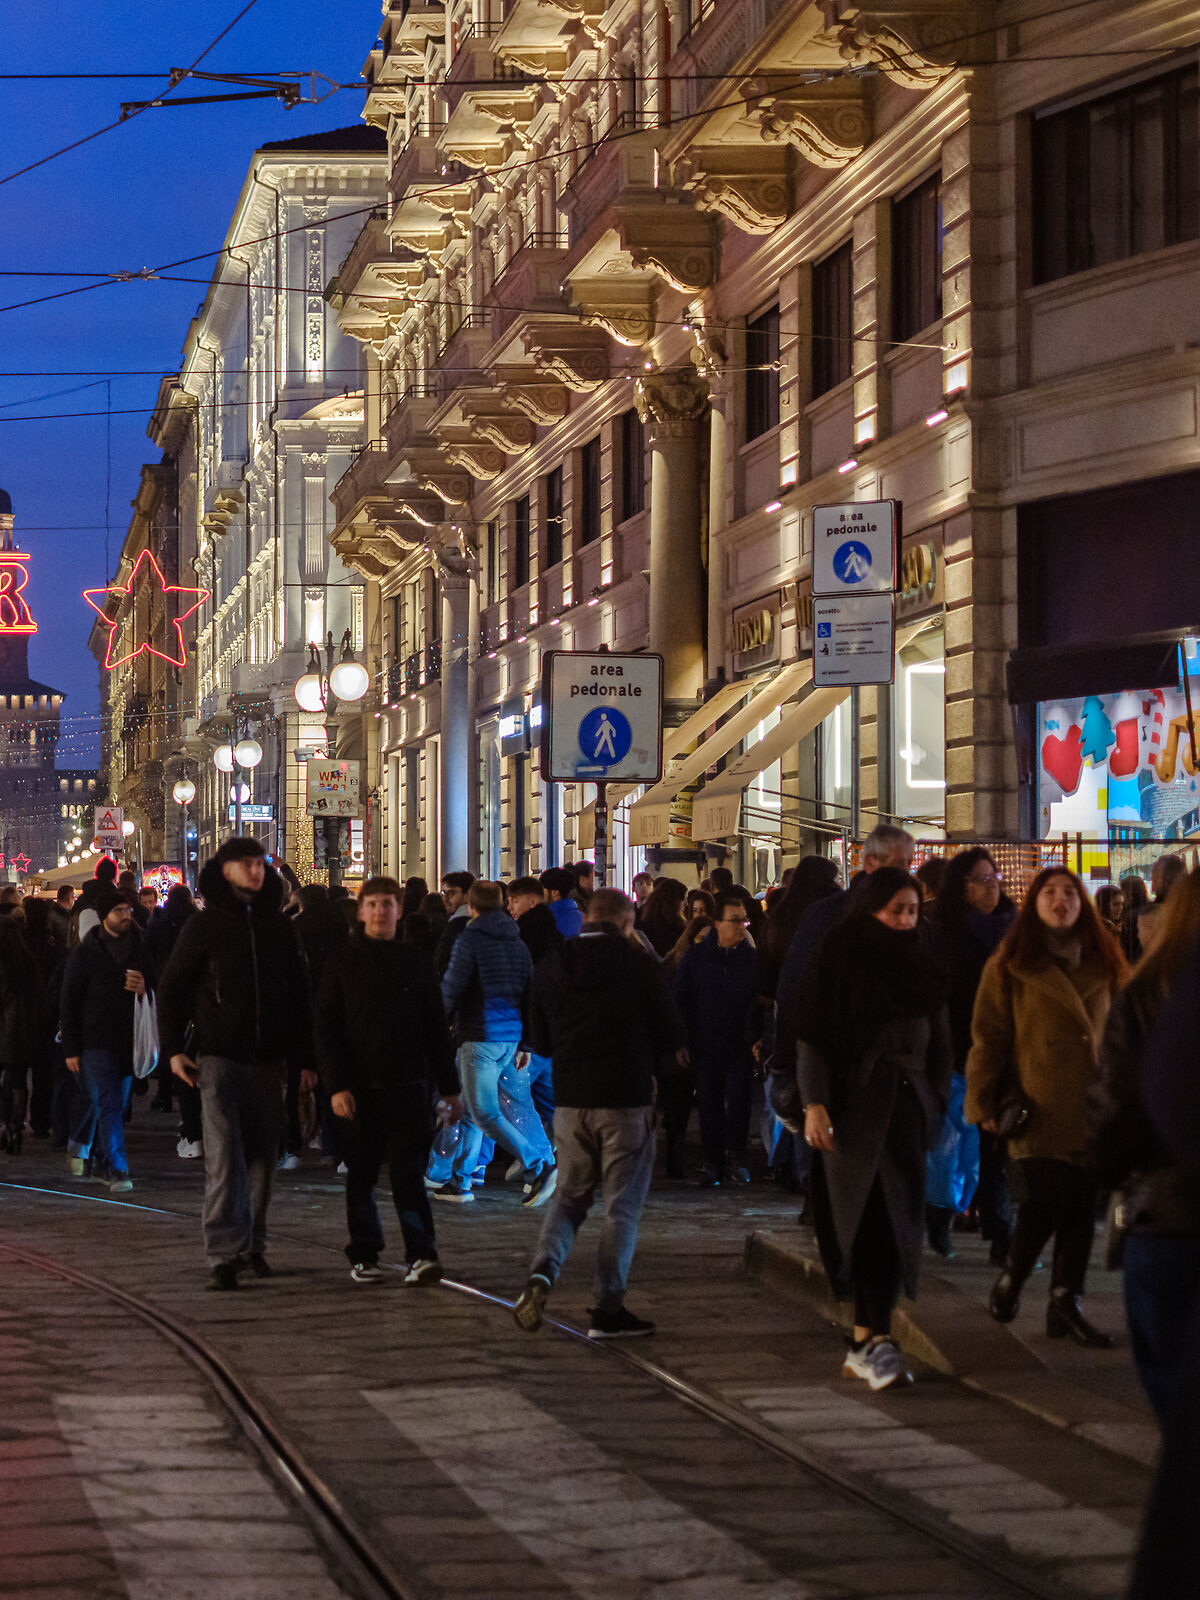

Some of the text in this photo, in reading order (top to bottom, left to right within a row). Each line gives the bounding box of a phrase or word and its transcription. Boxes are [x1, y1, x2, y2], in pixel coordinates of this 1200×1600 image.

[826, 522, 877, 538] pedonale
[590, 664, 624, 676] area
[570, 682, 642, 698] pedonale
